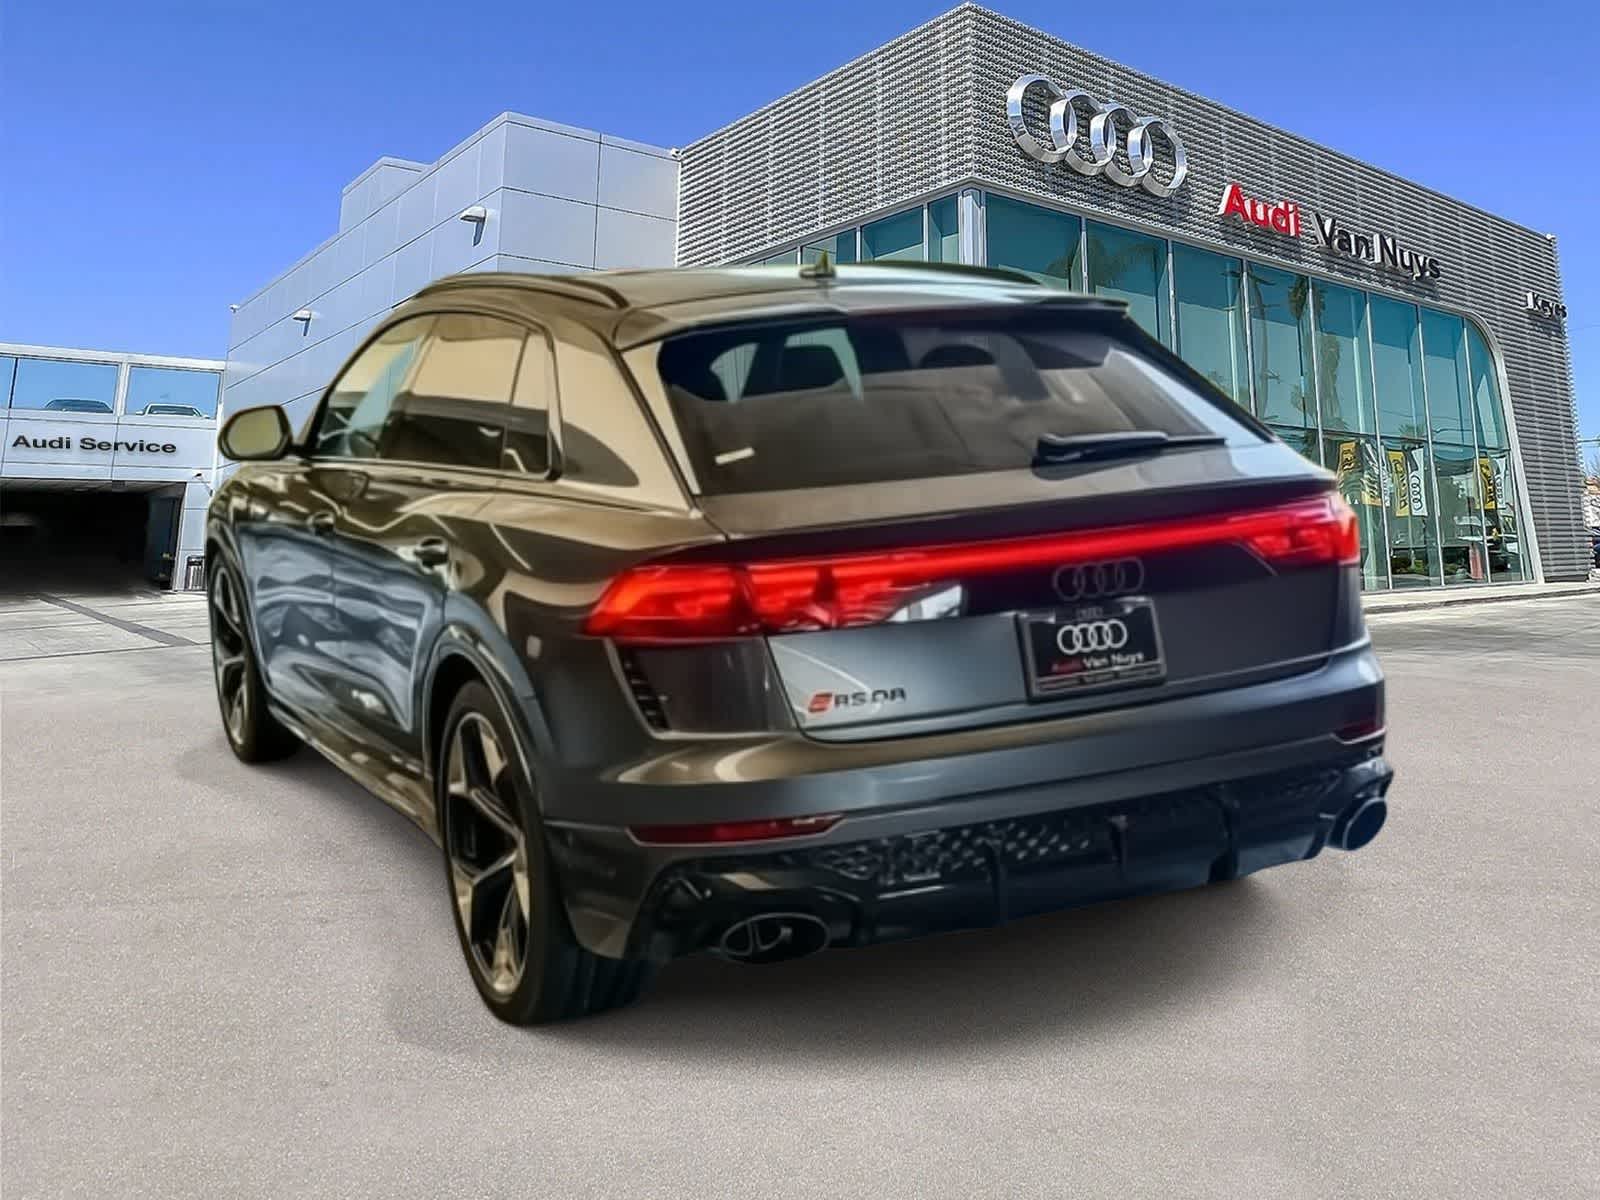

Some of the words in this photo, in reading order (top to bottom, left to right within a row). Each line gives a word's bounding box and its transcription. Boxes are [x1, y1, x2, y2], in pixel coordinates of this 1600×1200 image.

[1220, 183, 1303, 238] Audi
[1311, 211, 1371, 259] Van
[1372, 233, 1441, 281] Nuys
[12, 434, 71, 450] Audi
[79, 436, 177, 454] Service
